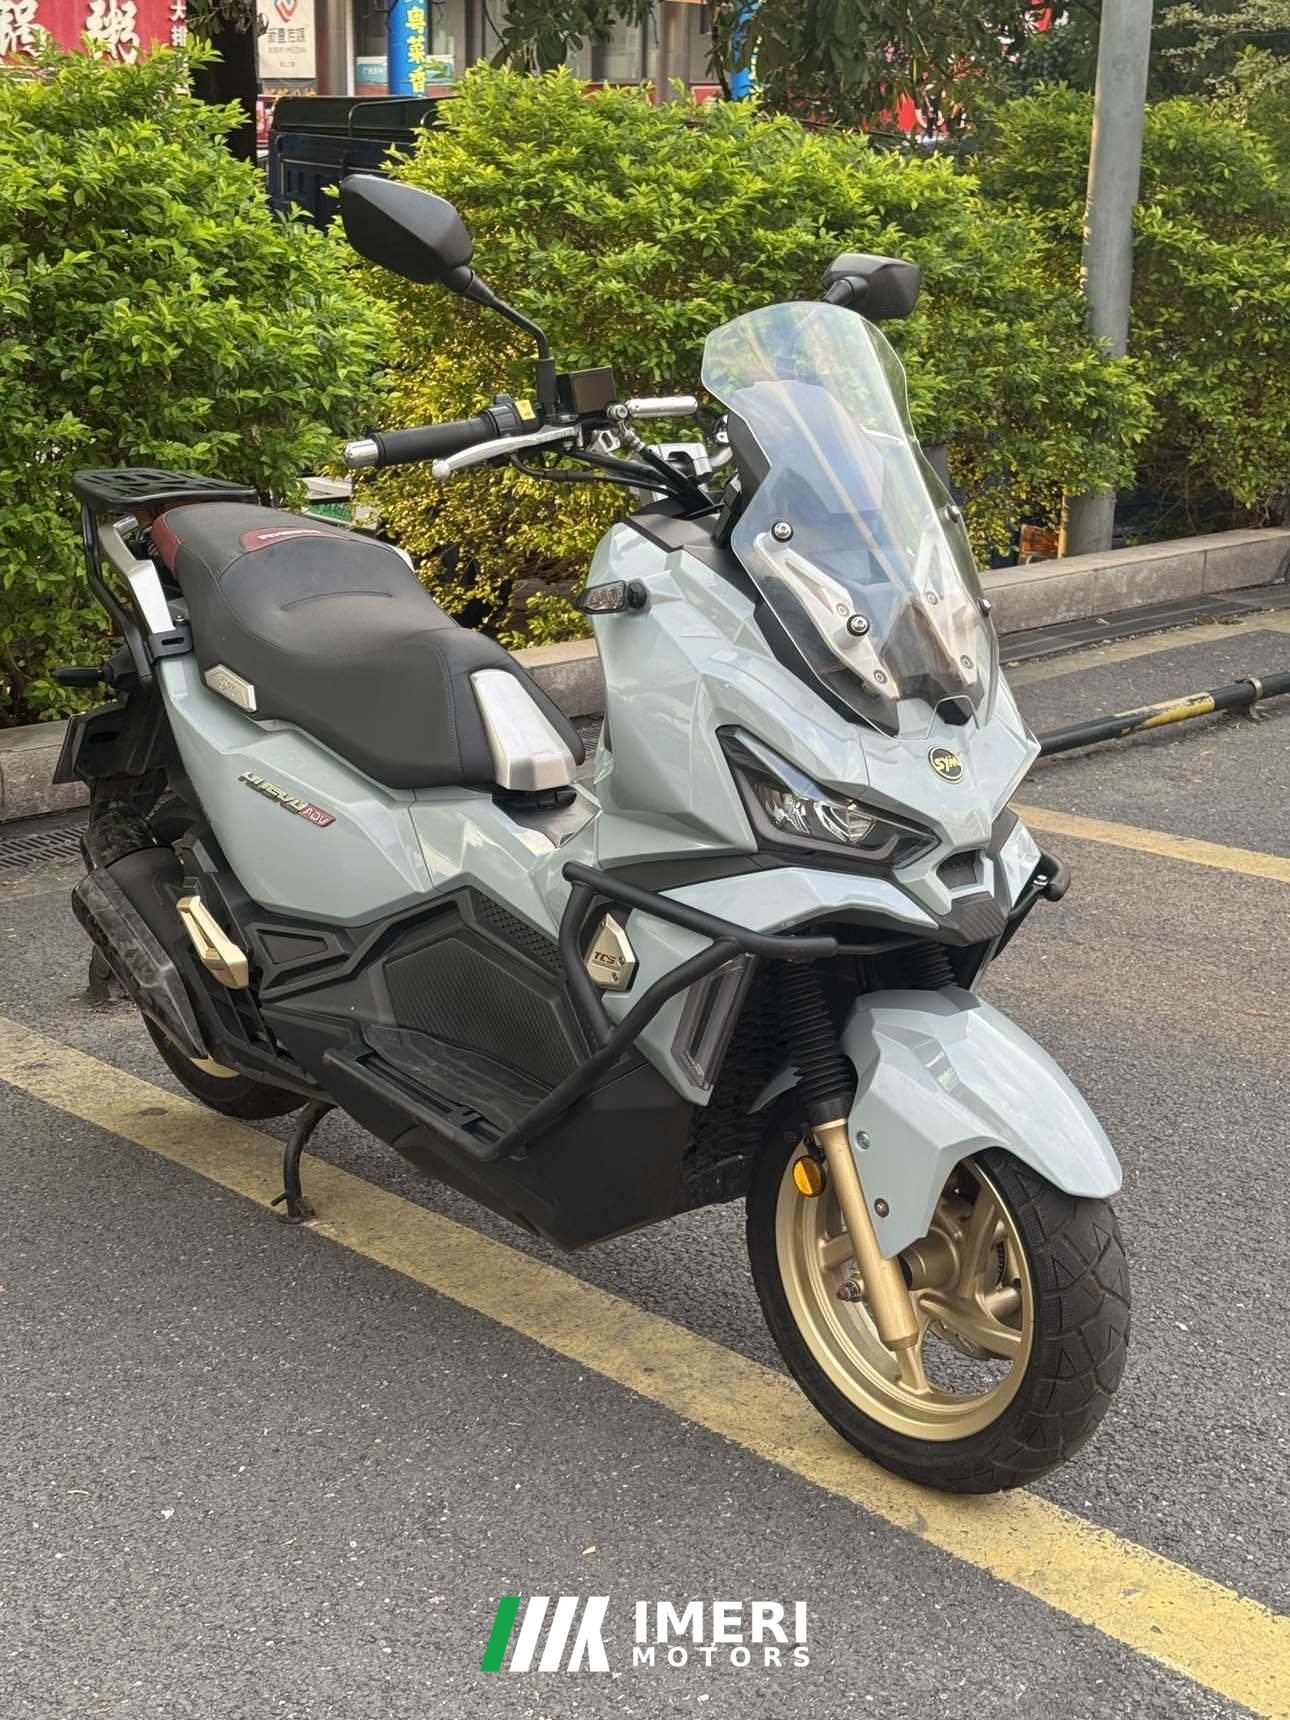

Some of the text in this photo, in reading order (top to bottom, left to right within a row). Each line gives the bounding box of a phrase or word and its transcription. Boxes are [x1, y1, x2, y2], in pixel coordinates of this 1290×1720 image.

[934, 755, 961, 772] SYM
[302, 807, 330, 826] ADV
[594, 951, 616, 965] TCS
